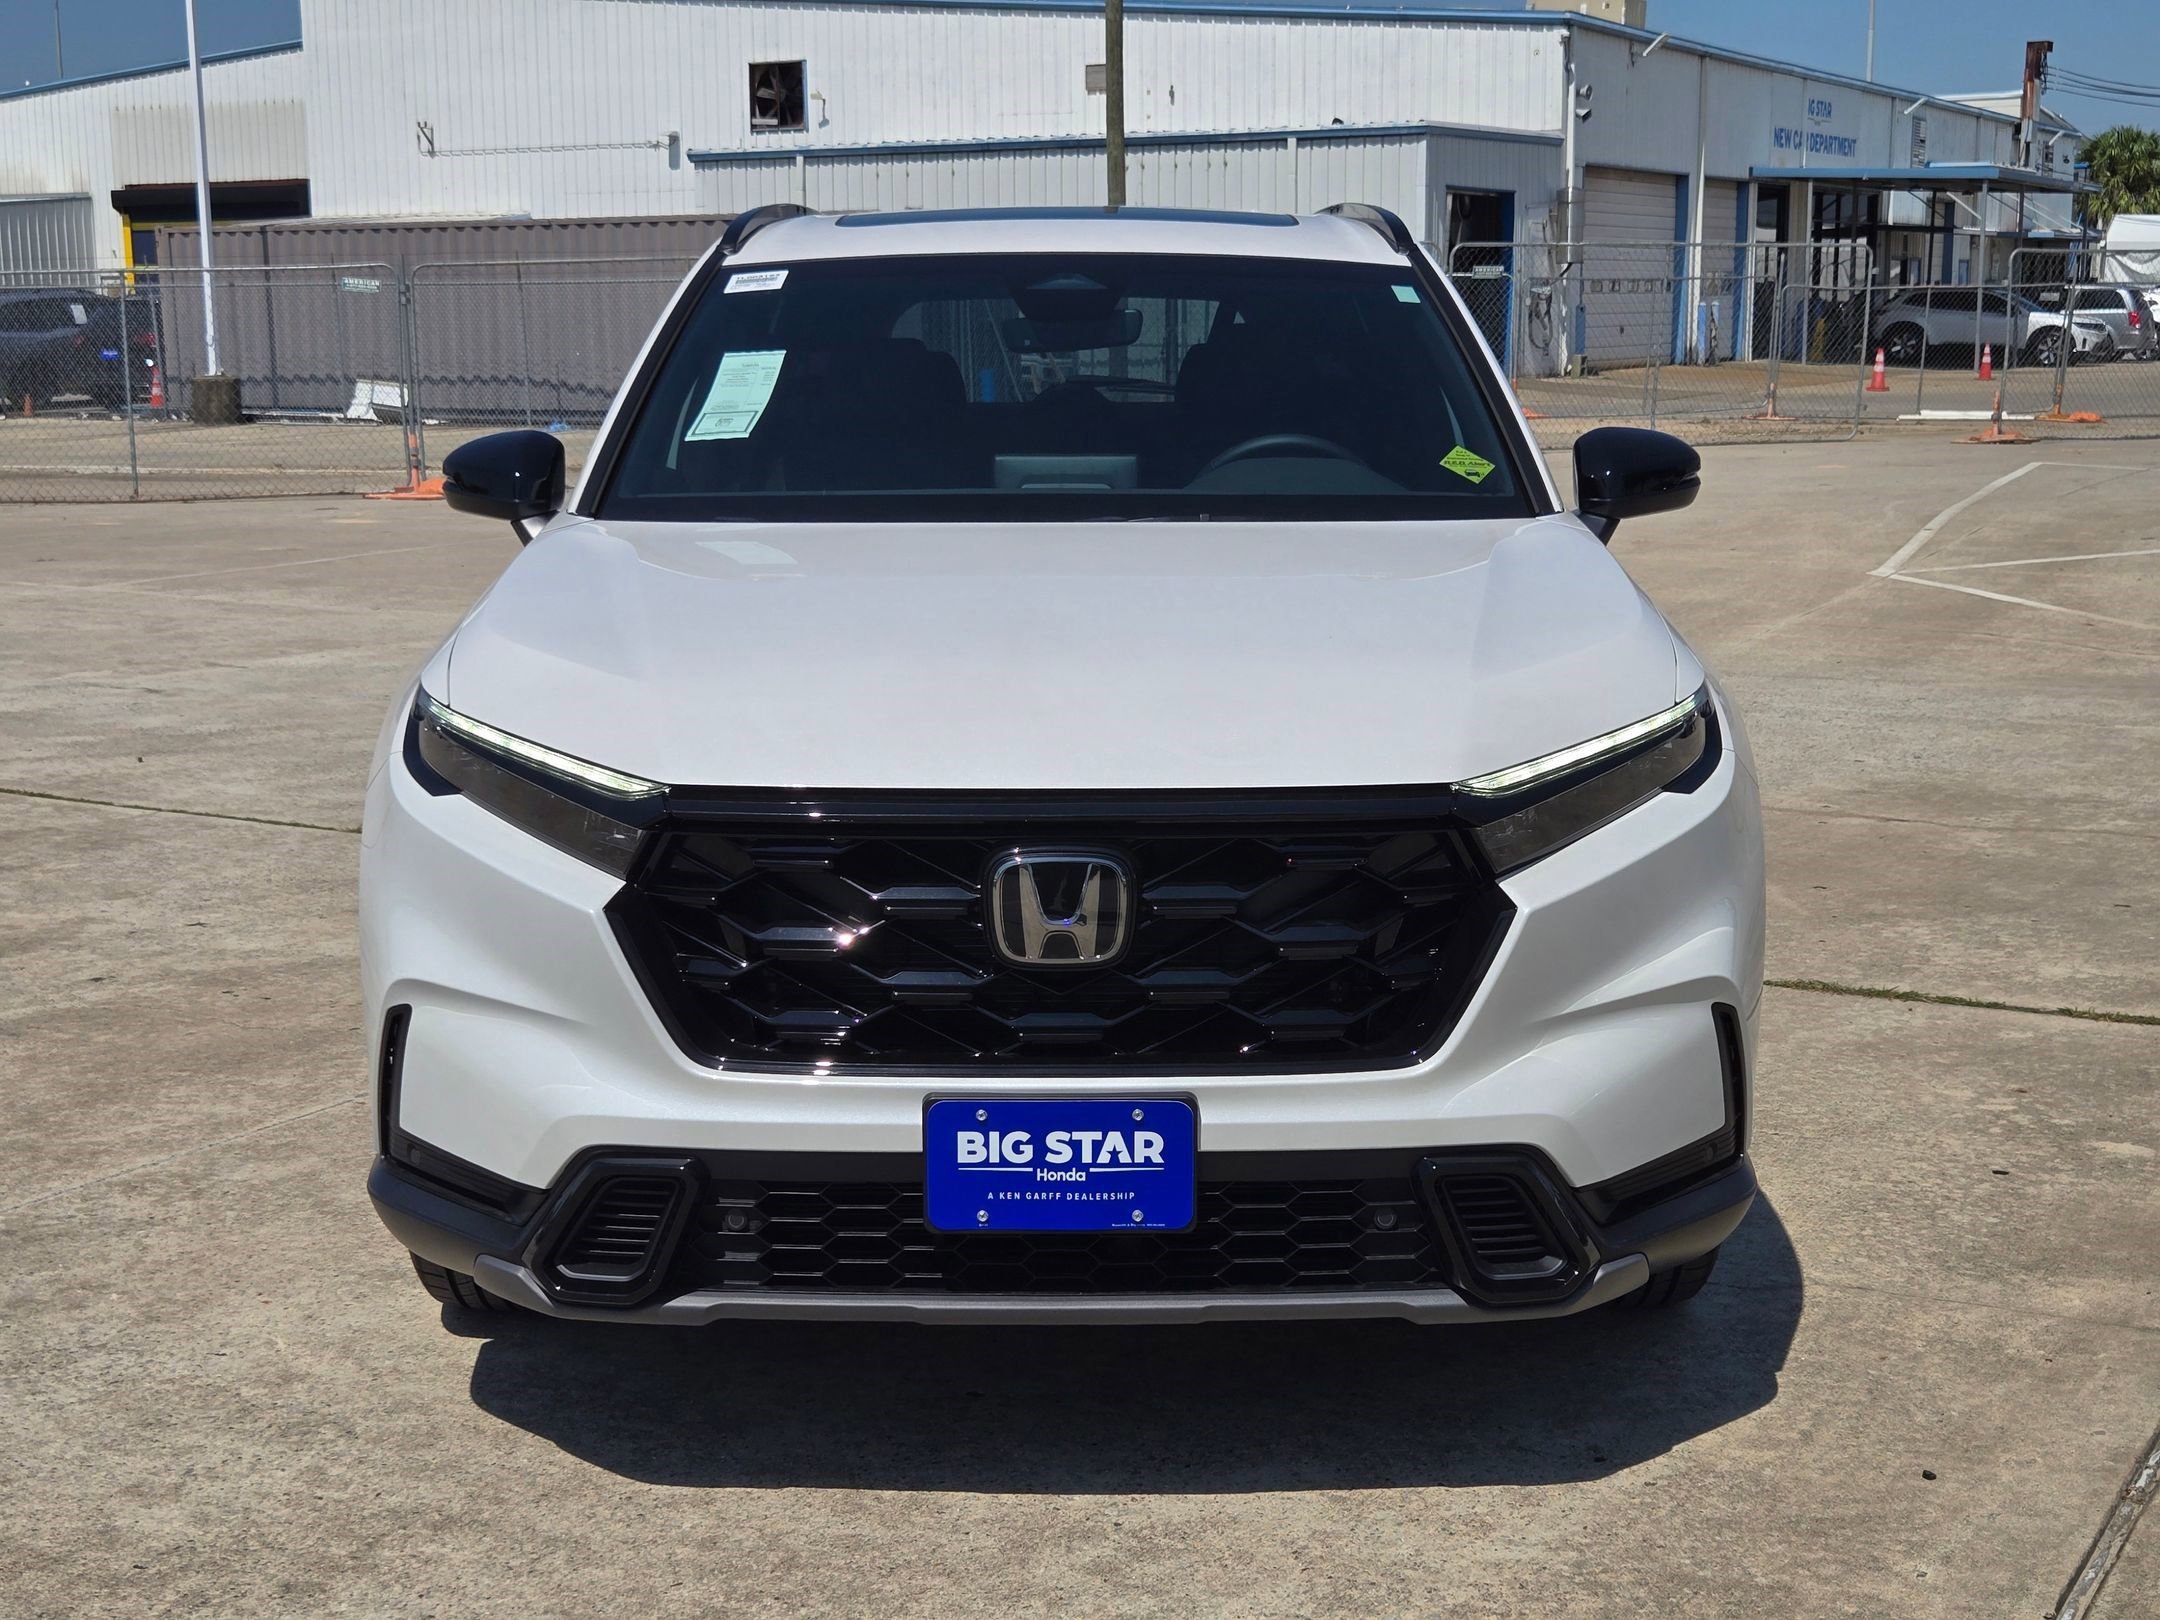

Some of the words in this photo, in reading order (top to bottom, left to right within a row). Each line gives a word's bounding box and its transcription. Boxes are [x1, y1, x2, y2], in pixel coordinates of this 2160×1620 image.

[1816, 100, 1832, 118] STAR
[1773, 127, 1792, 149] NEW
[1809, 132, 1857, 158] DEPARTMENT
[344, 277, 380, 285] AMERICAN
[957, 1131, 1033, 1164] BIG
[1045, 1131, 1164, 1164] STAR
[1036, 1167, 1086, 1181] Honda
[987, 1191, 994, 1200] A
[1000, 1191, 1020, 1200] KEN
[1025, 1191, 1061, 1200] GARFF
[1066, 1191, 1135, 1201] DEALERSHIP
